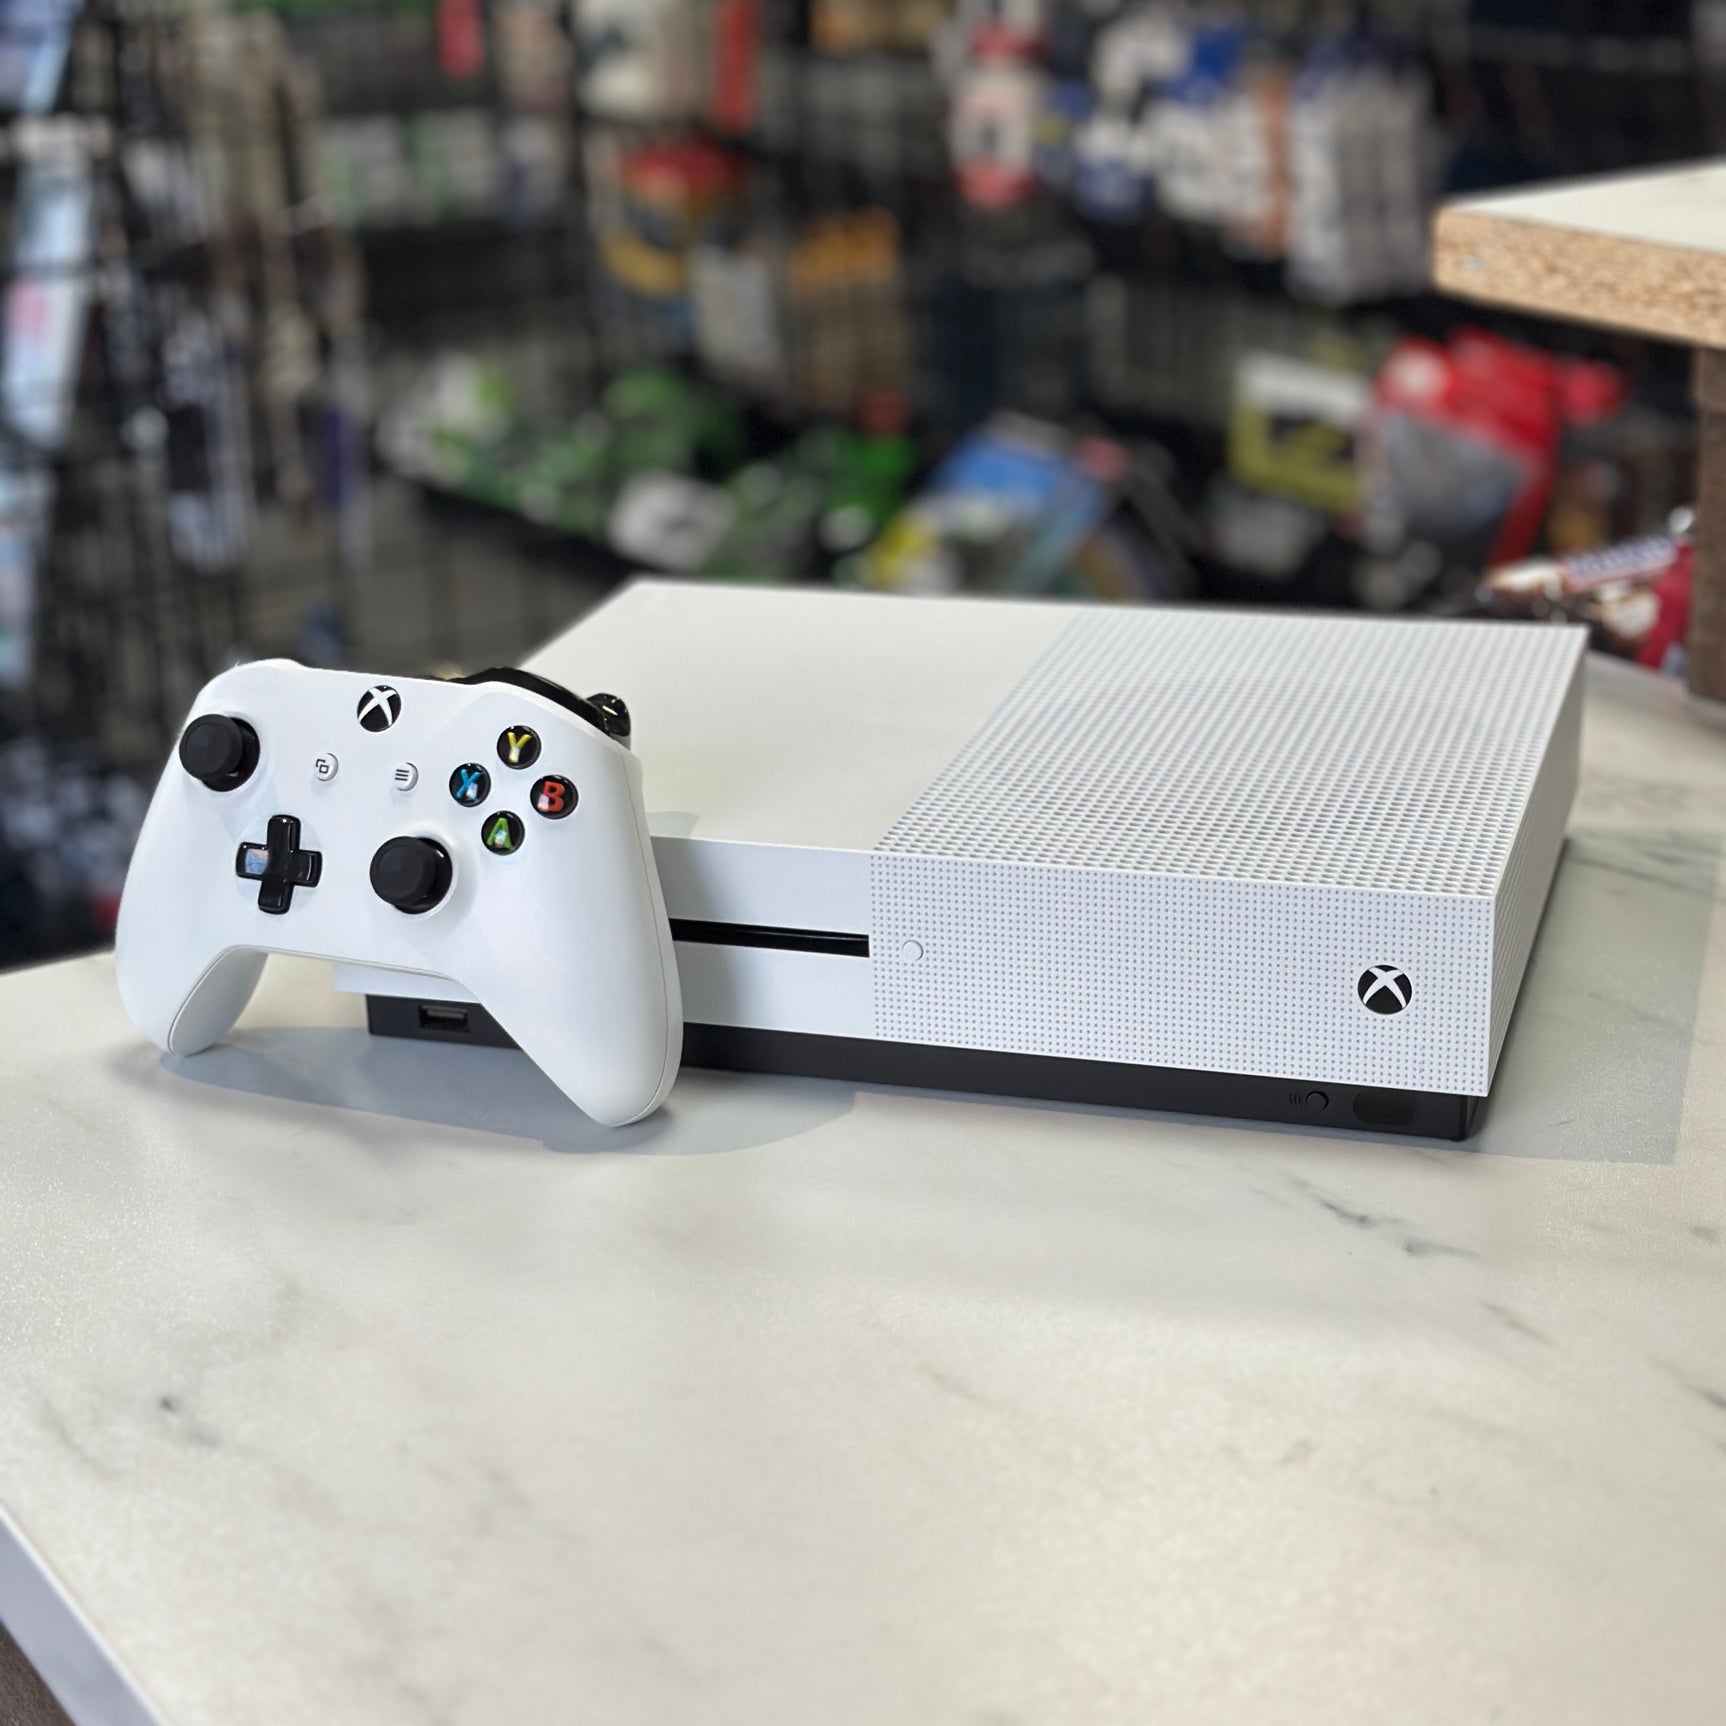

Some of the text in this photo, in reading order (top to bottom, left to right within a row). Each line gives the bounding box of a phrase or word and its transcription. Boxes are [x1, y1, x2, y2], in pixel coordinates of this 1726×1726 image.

[507, 731, 533, 763] Y
[455, 768, 484, 800] X
[537, 780, 566, 812] B
[486, 817, 515, 850] A
